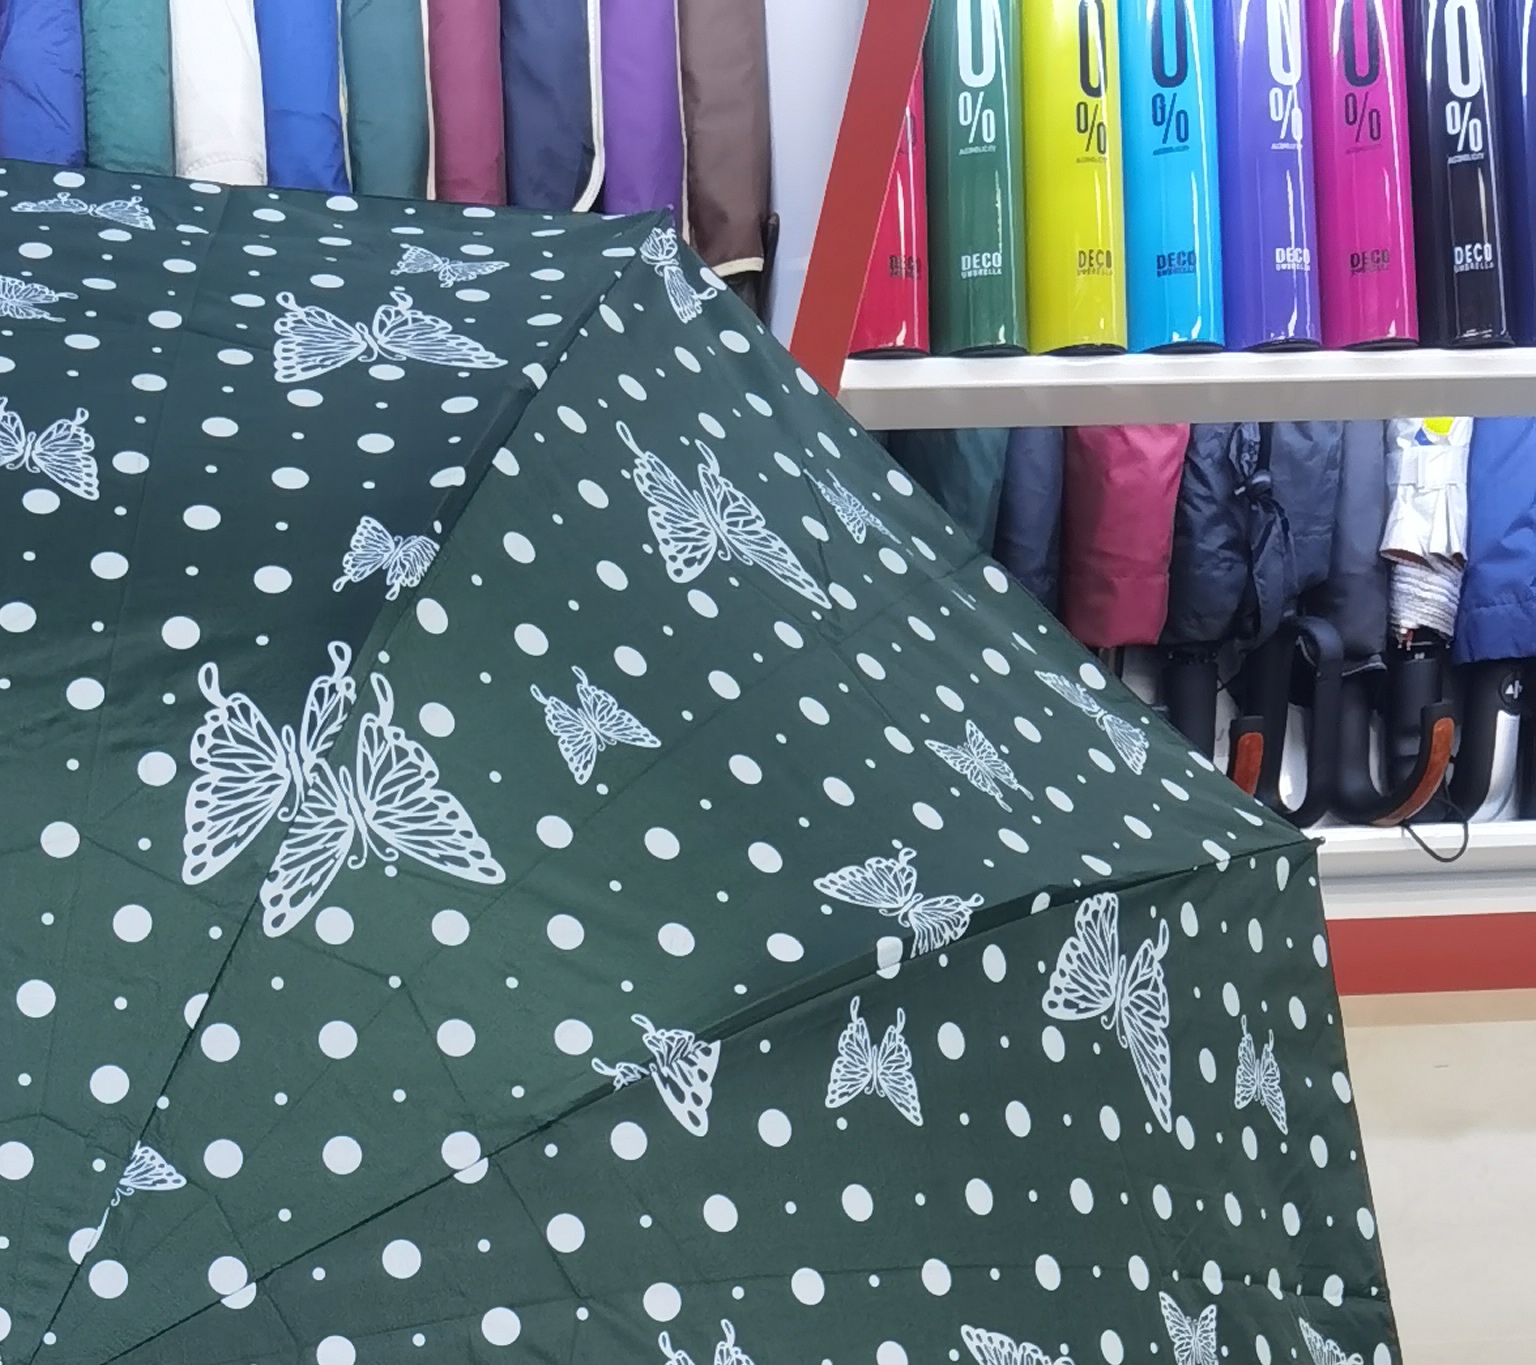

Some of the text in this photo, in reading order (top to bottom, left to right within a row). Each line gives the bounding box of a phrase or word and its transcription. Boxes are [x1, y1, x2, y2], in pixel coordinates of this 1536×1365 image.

[960, 252, 1002, 270] DECO
[1078, 249, 1112, 269] DECO
[1156, 251, 1196, 270] DECO
[1275, 247, 1310, 264] DECO
[1350, 249, 1390, 269] DECO
[1454, 243, 1493, 265] DECO
